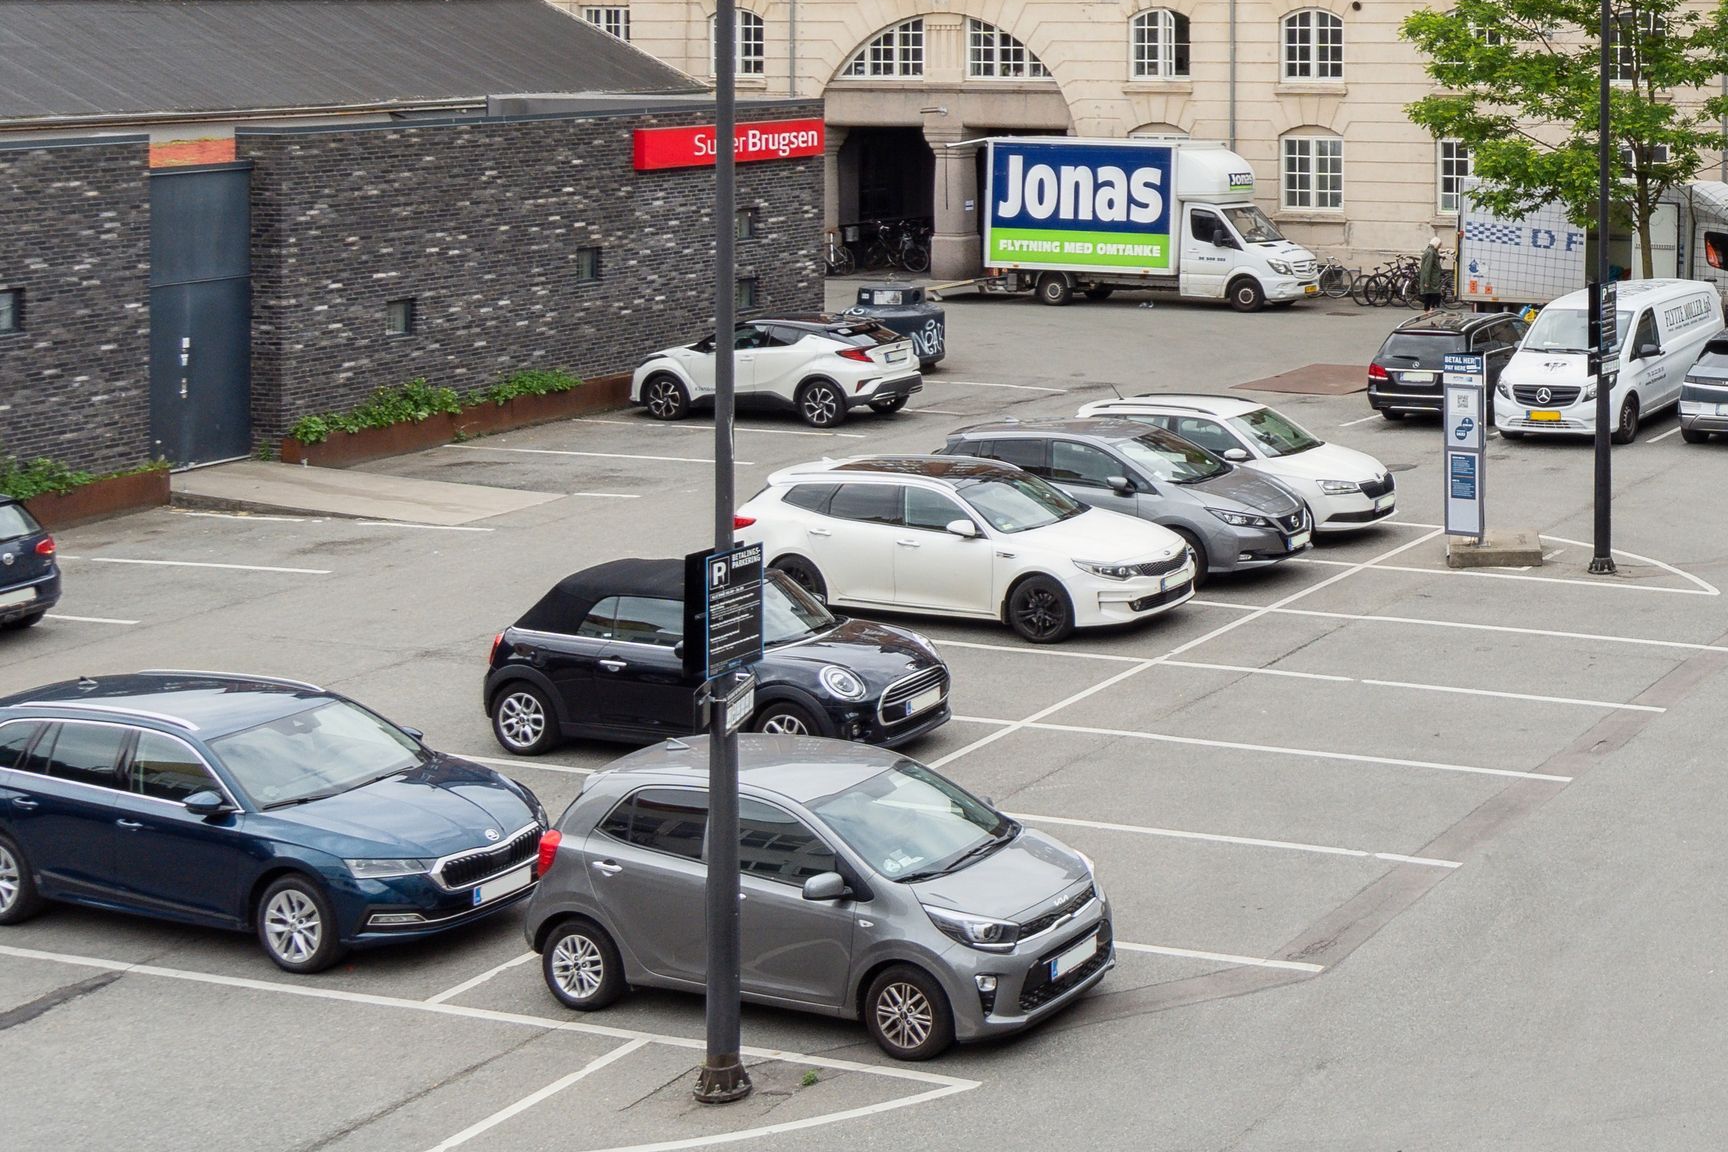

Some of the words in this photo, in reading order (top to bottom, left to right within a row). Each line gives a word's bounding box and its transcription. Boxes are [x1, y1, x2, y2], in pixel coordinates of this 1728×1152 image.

[694, 130, 818, 156] SuerBrugsen
[998, 155, 1163, 224] Jonas
[999, 239, 1060, 253] FLYTNING
[1064, 241, 1092, 254] MED
[1097, 242, 1161, 257] OMTANKE
[713, 561, 727, 586] P
